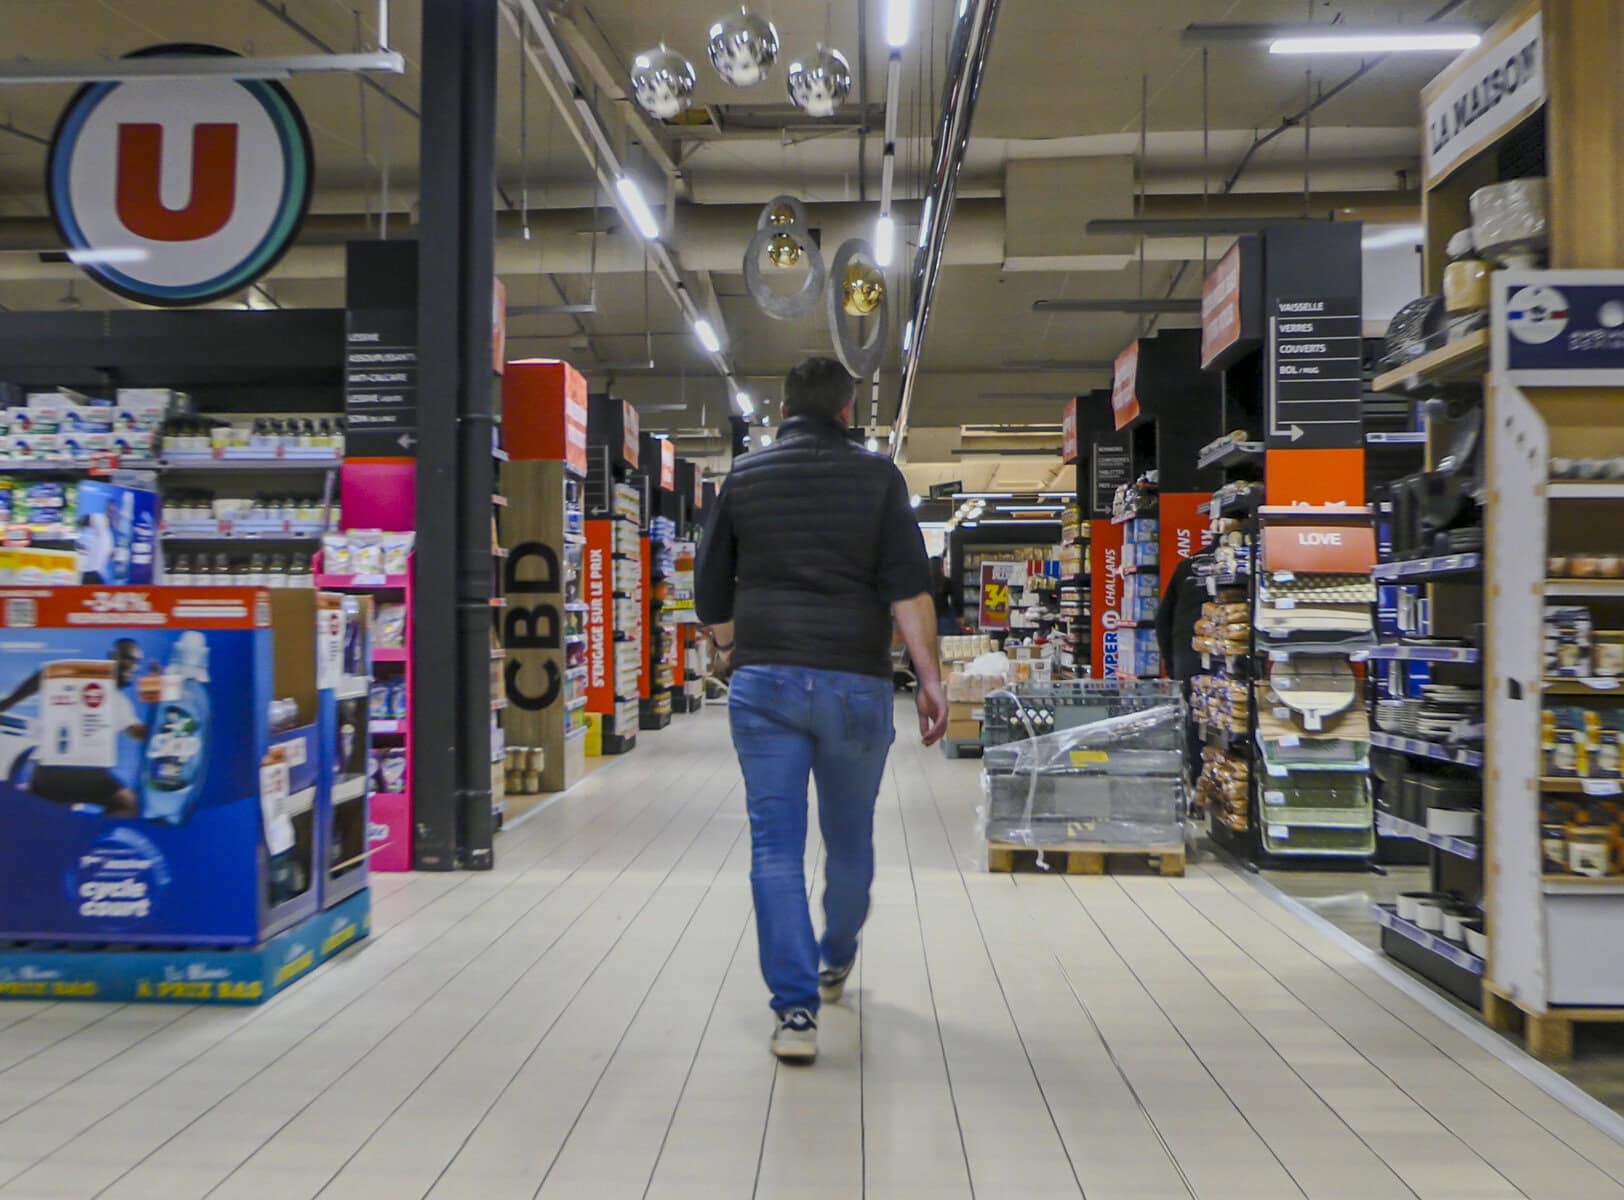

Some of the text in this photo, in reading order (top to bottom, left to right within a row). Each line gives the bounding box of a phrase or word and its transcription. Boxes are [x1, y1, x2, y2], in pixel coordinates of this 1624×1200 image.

[116, 122, 238, 242] U
[1279, 302, 1325, 312] VAISSELLE
[1279, 323, 1314, 333] VERRES
[1279, 344, 1327, 354] COUVERTS
[1279, 365, 1298, 375] BOL
[1298, 532, 1342, 546] LOVE
[1104, 547, 1117, 607] CHALLANS
[589, 548, 605, 688] S'ENGAGE SUR LE PRIX
[504, 541, 561, 711] CBD
